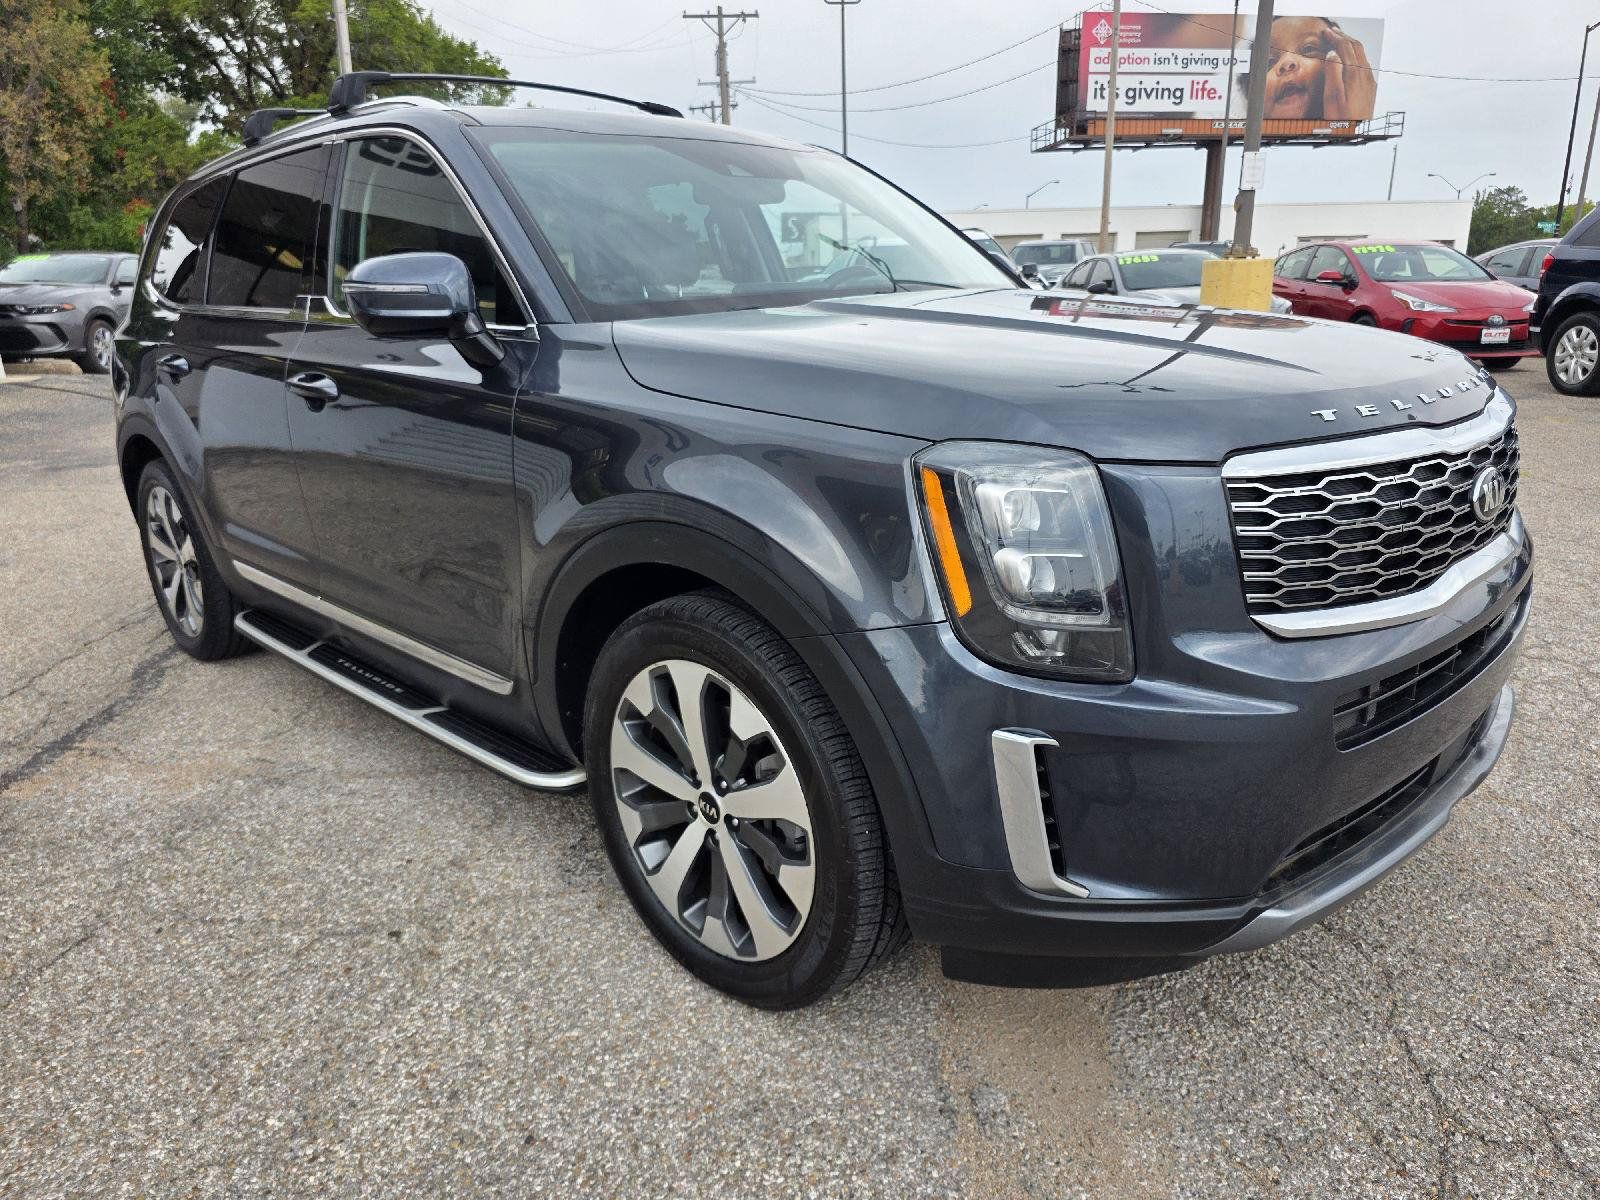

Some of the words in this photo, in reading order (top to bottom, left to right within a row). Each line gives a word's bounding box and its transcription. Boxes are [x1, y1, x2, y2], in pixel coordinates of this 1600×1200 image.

[1094, 52, 1150, 68] adption
[1153, 53, 1178, 66] isn't
[1181, 53, 1219, 69] giving
[1125, 81, 1184, 105] giving
[1189, 80, 1222, 100] life.
[700, 799, 718, 819] KIA
